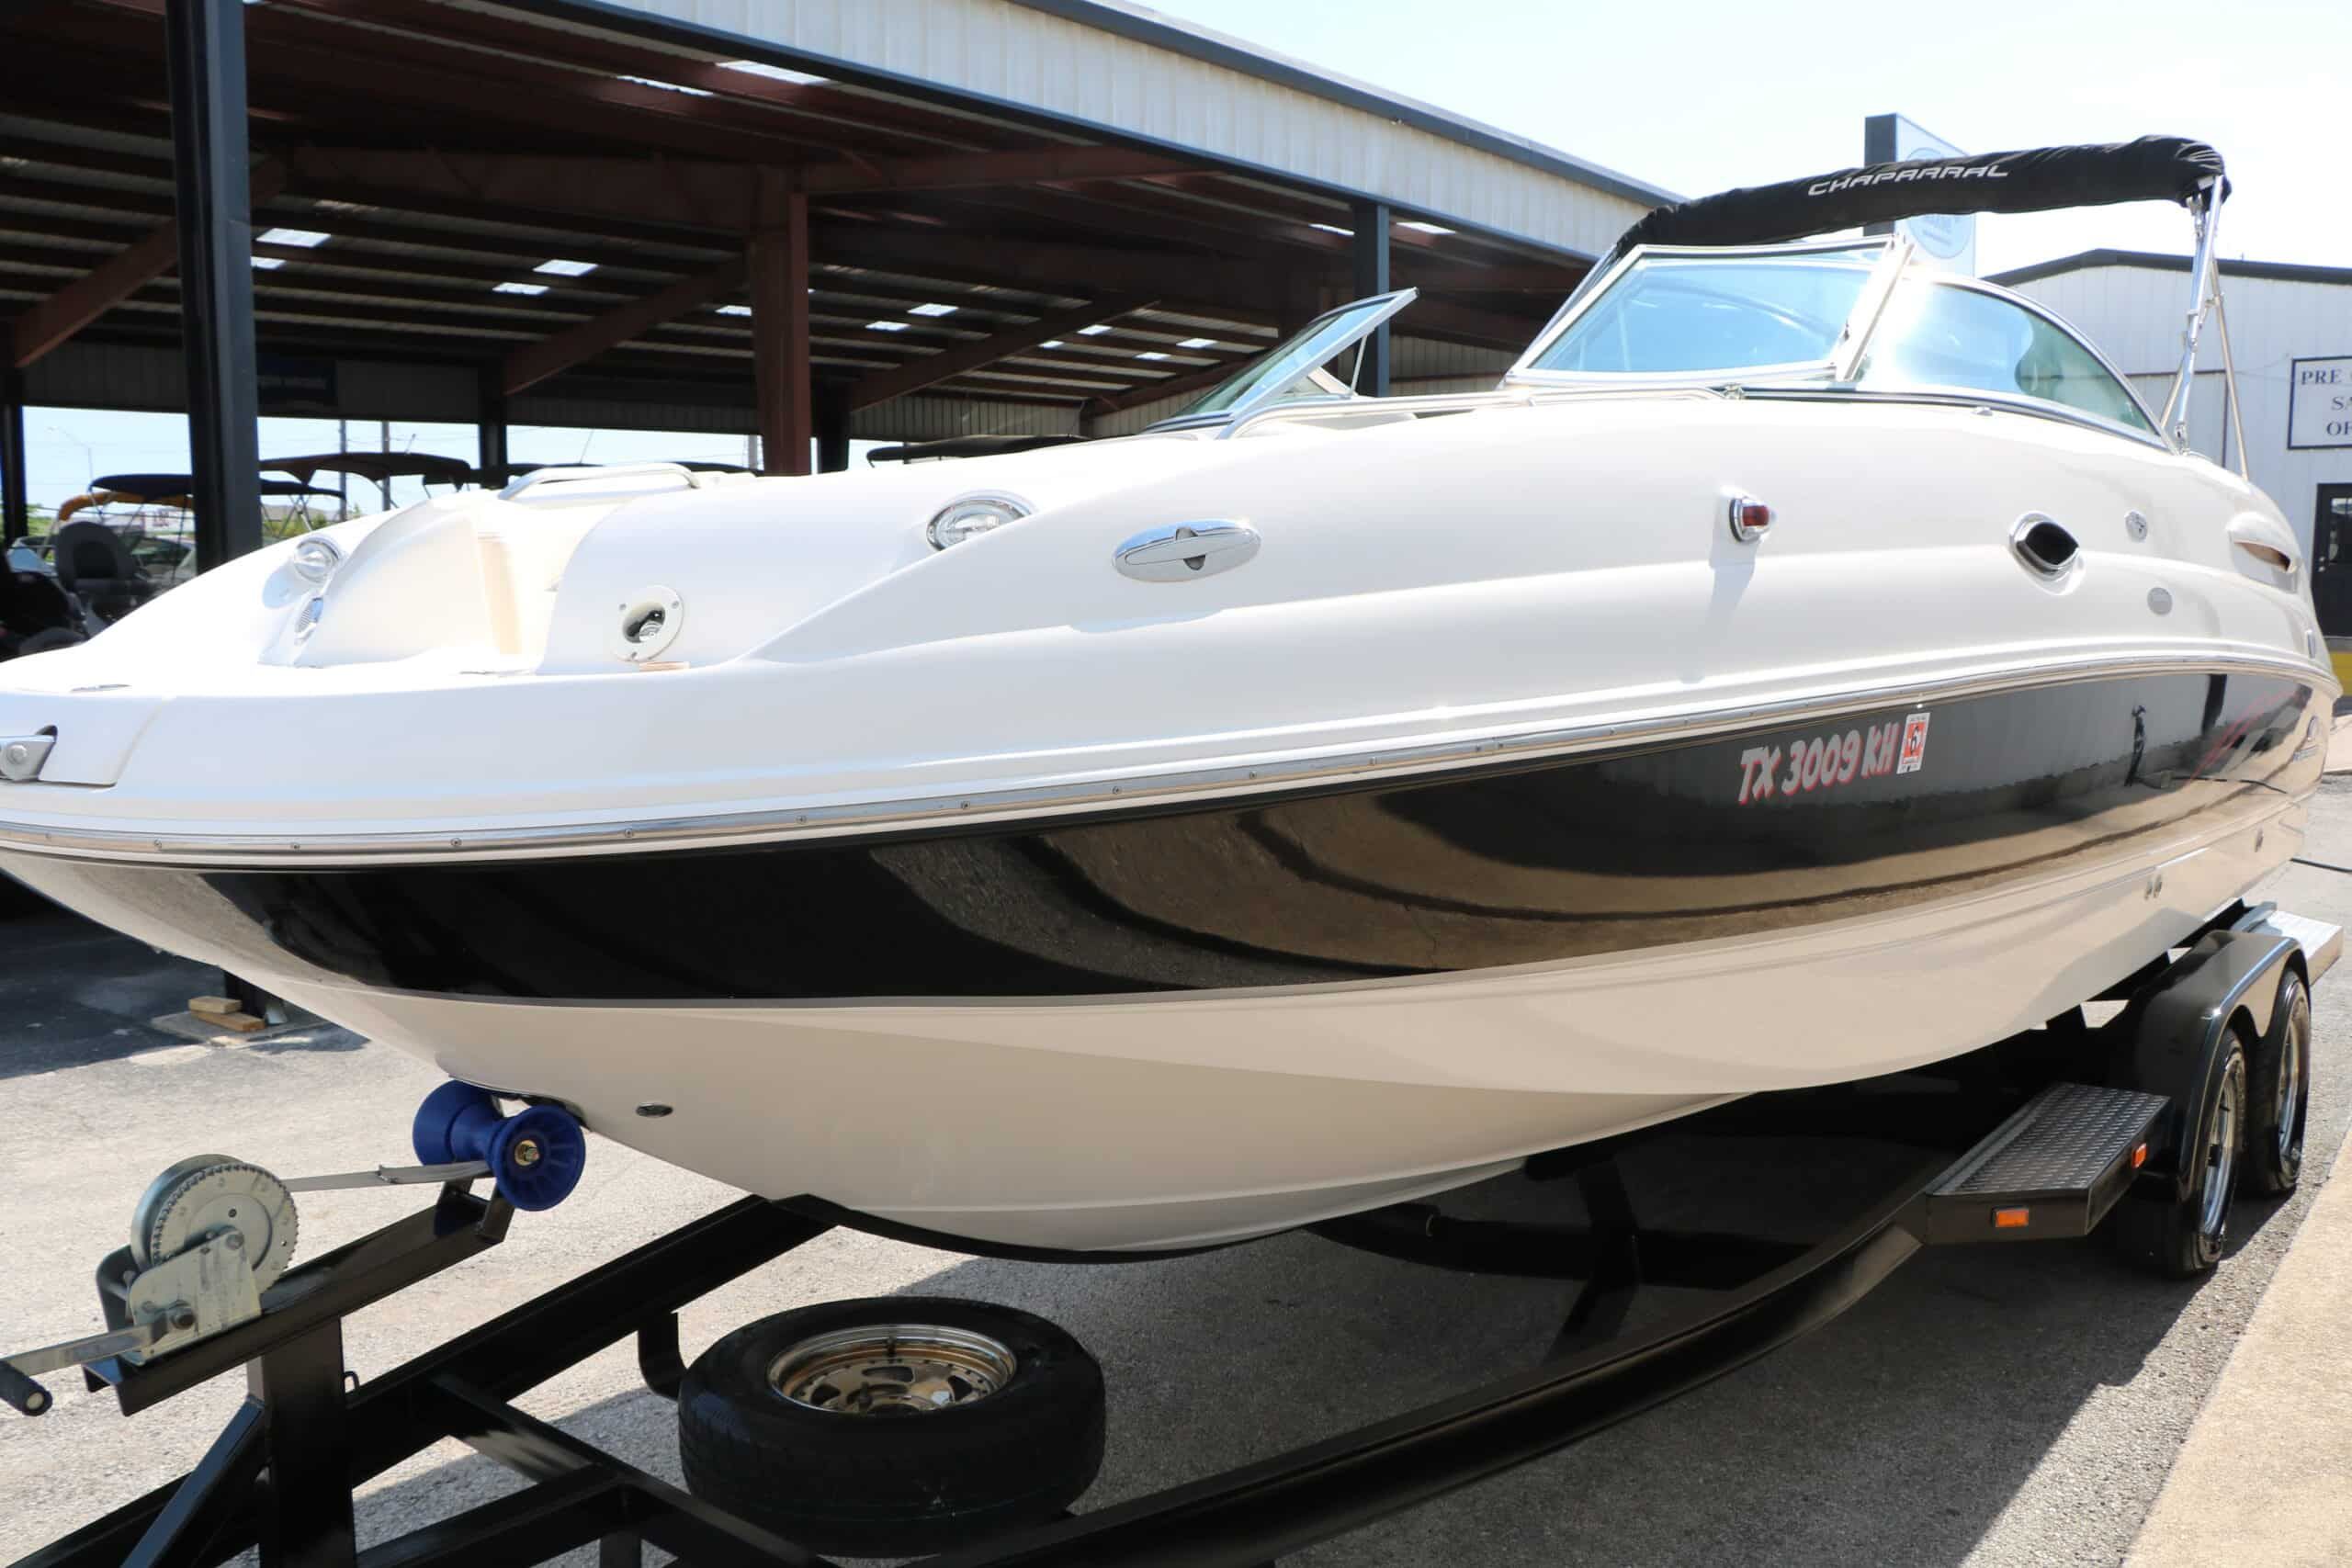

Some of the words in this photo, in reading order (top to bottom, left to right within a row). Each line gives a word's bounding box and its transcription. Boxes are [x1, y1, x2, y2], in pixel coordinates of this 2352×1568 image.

[1807, 165, 2008, 196] CHAPARRAL
[2301, 369, 2342, 386] PRE
[1738, 747, 1781, 805] TX
[1781, 729, 1863, 795] 3009
[1860, 722, 1899, 778] KH
